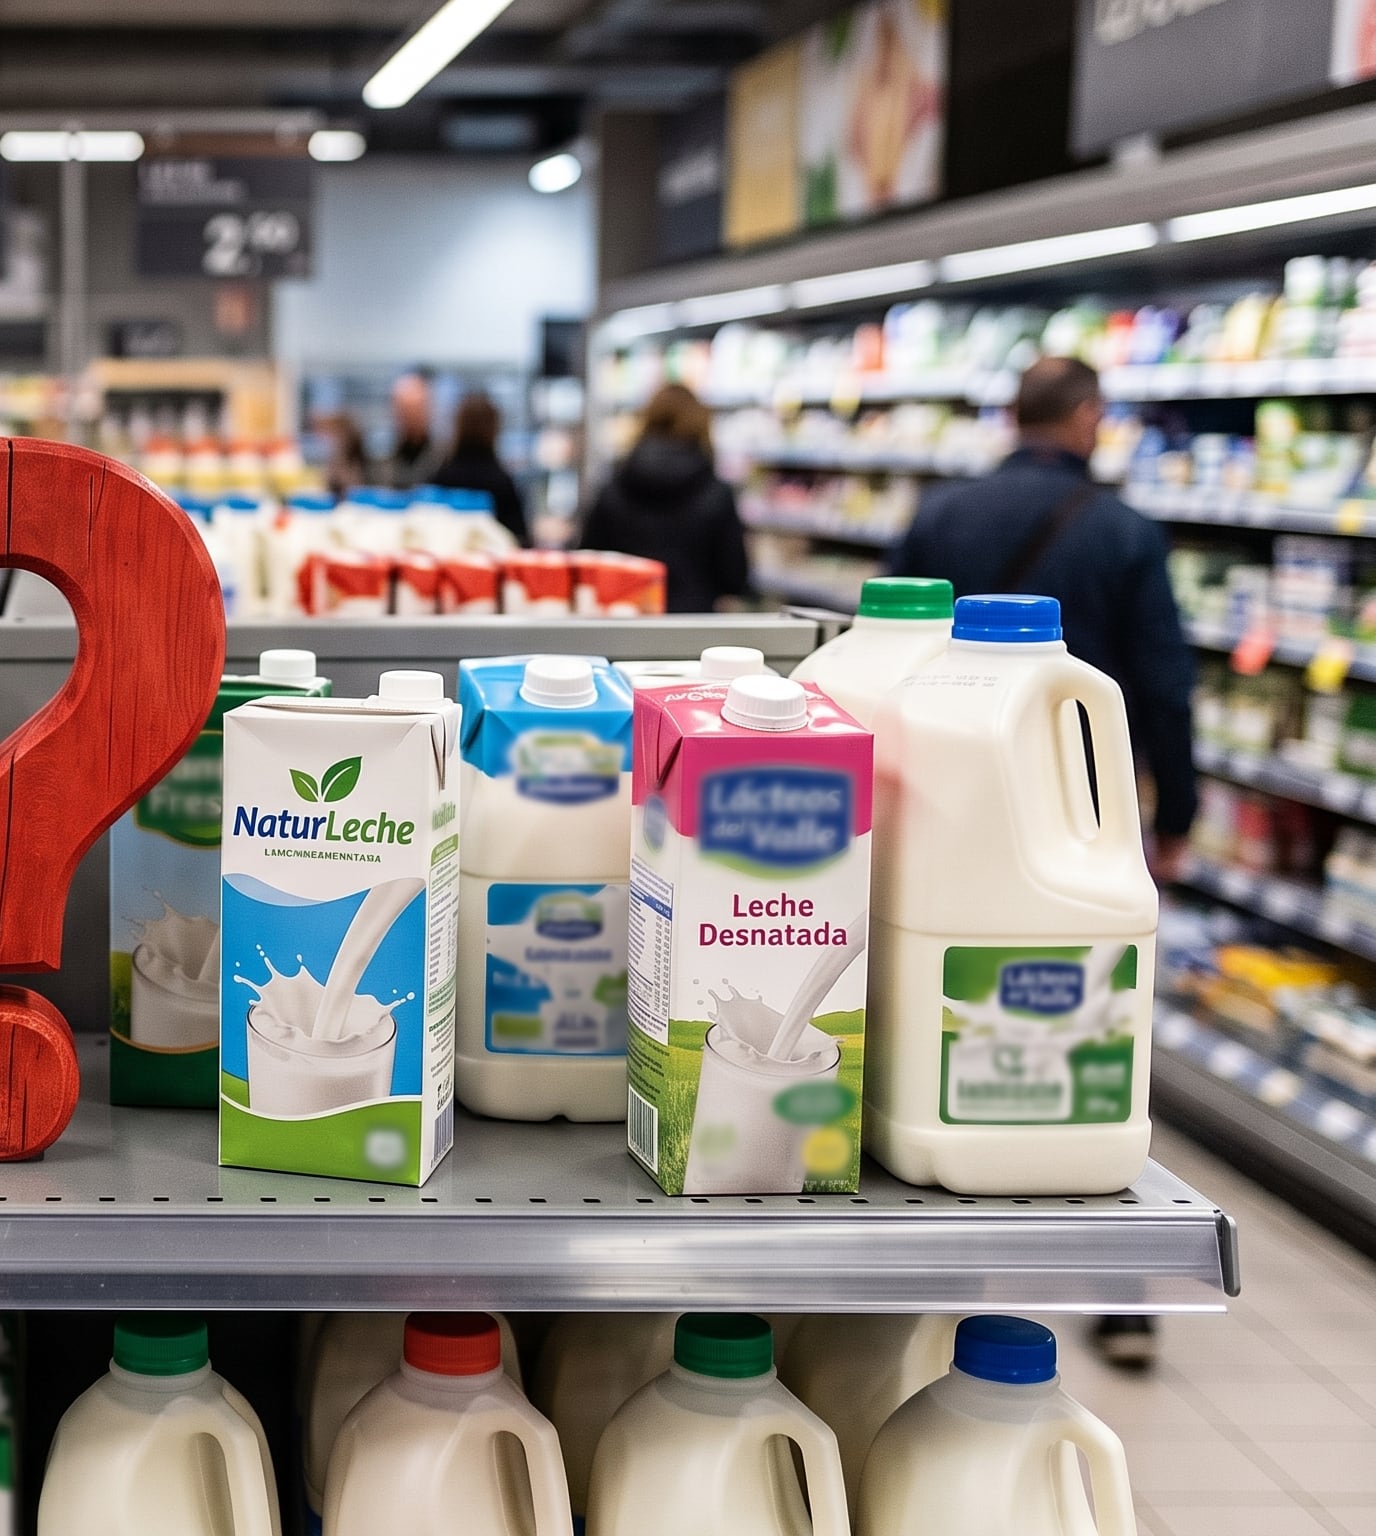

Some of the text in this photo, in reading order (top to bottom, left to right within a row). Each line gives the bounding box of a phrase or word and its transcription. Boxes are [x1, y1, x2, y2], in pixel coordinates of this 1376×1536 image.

[233, 806, 415, 845] NaturLeche
[733, 893, 814, 917] Leche
[699, 922, 847, 946] Desnatada
